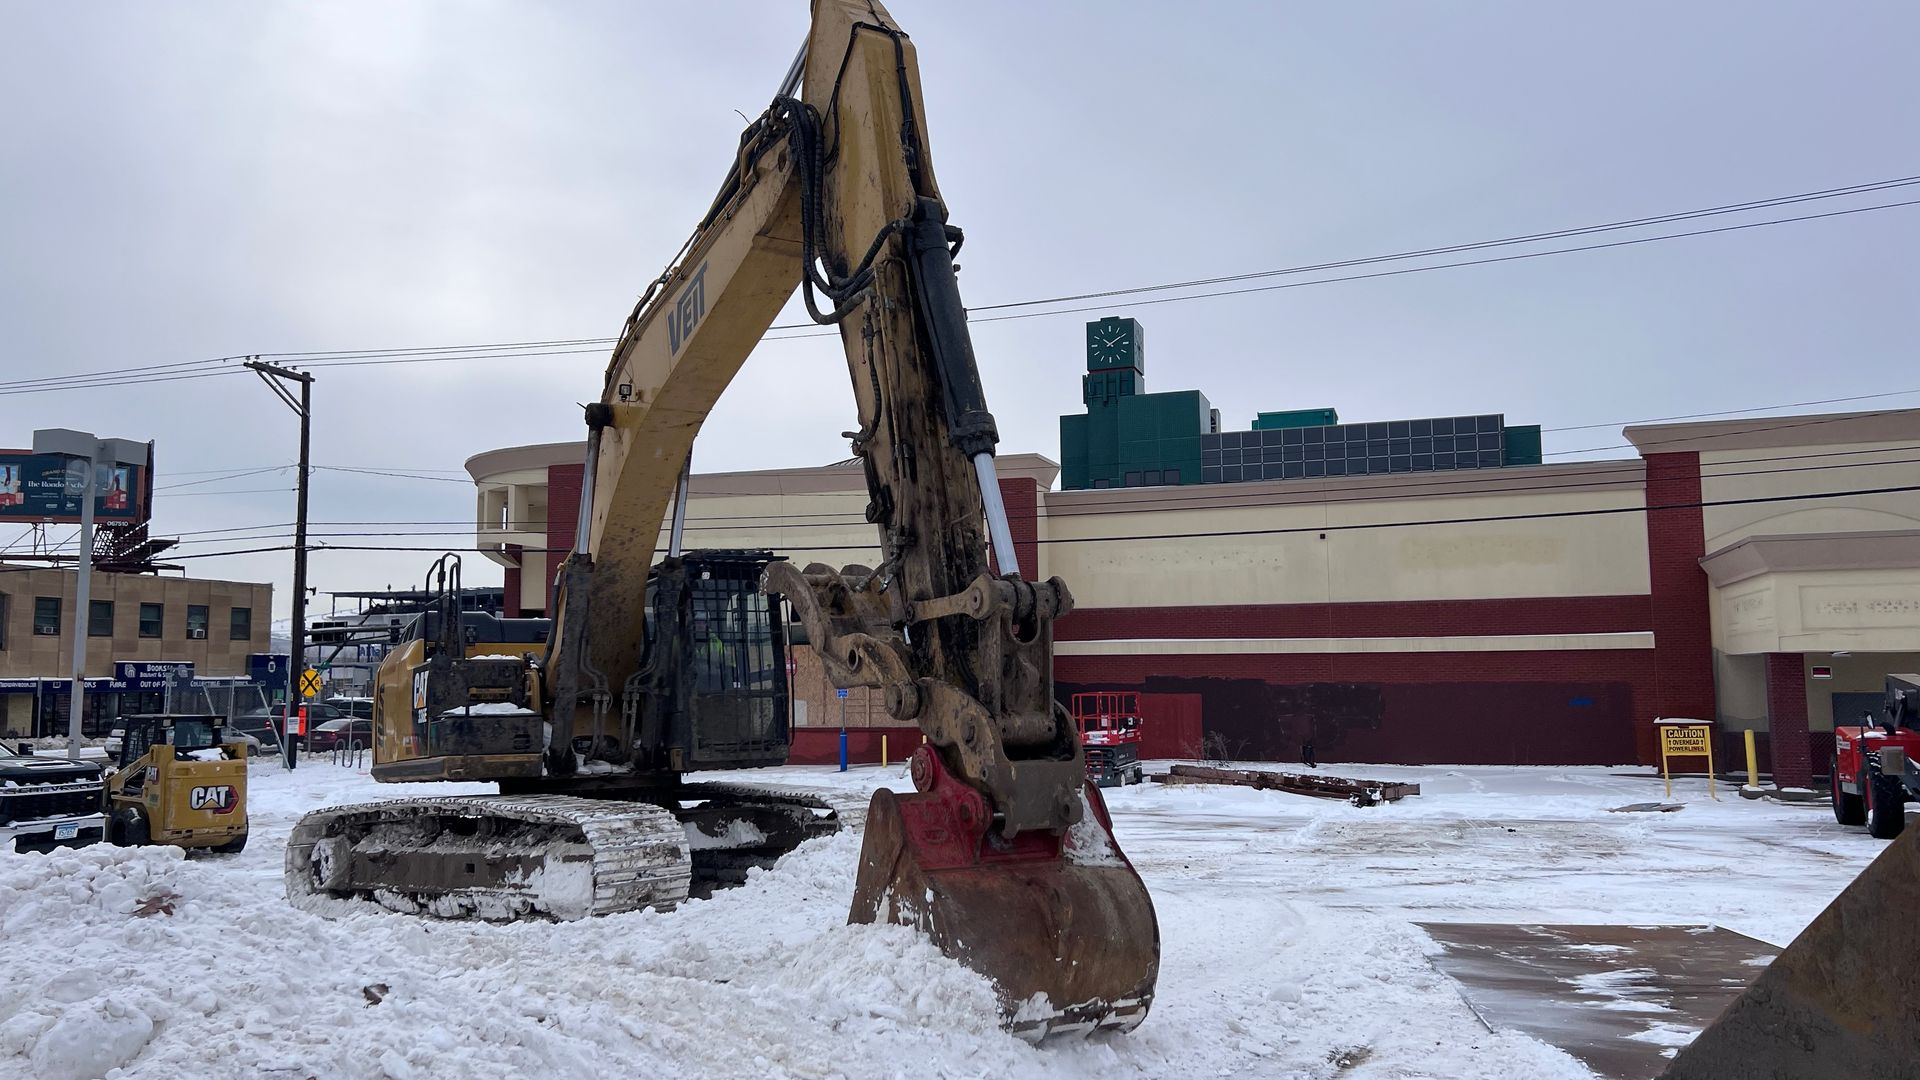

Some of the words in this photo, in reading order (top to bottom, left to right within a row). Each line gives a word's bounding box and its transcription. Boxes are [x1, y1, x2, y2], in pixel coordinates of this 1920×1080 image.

[667, 261, 708, 356] VEIT
[28, 480, 40, 488] The
[41, 480, 65, 488] Rondo
[414, 670, 429, 709] CAT
[1667, 729, 1704, 738] CAUTION
[146, 766, 158, 781] CAT
[191, 786, 230, 810] CAT
